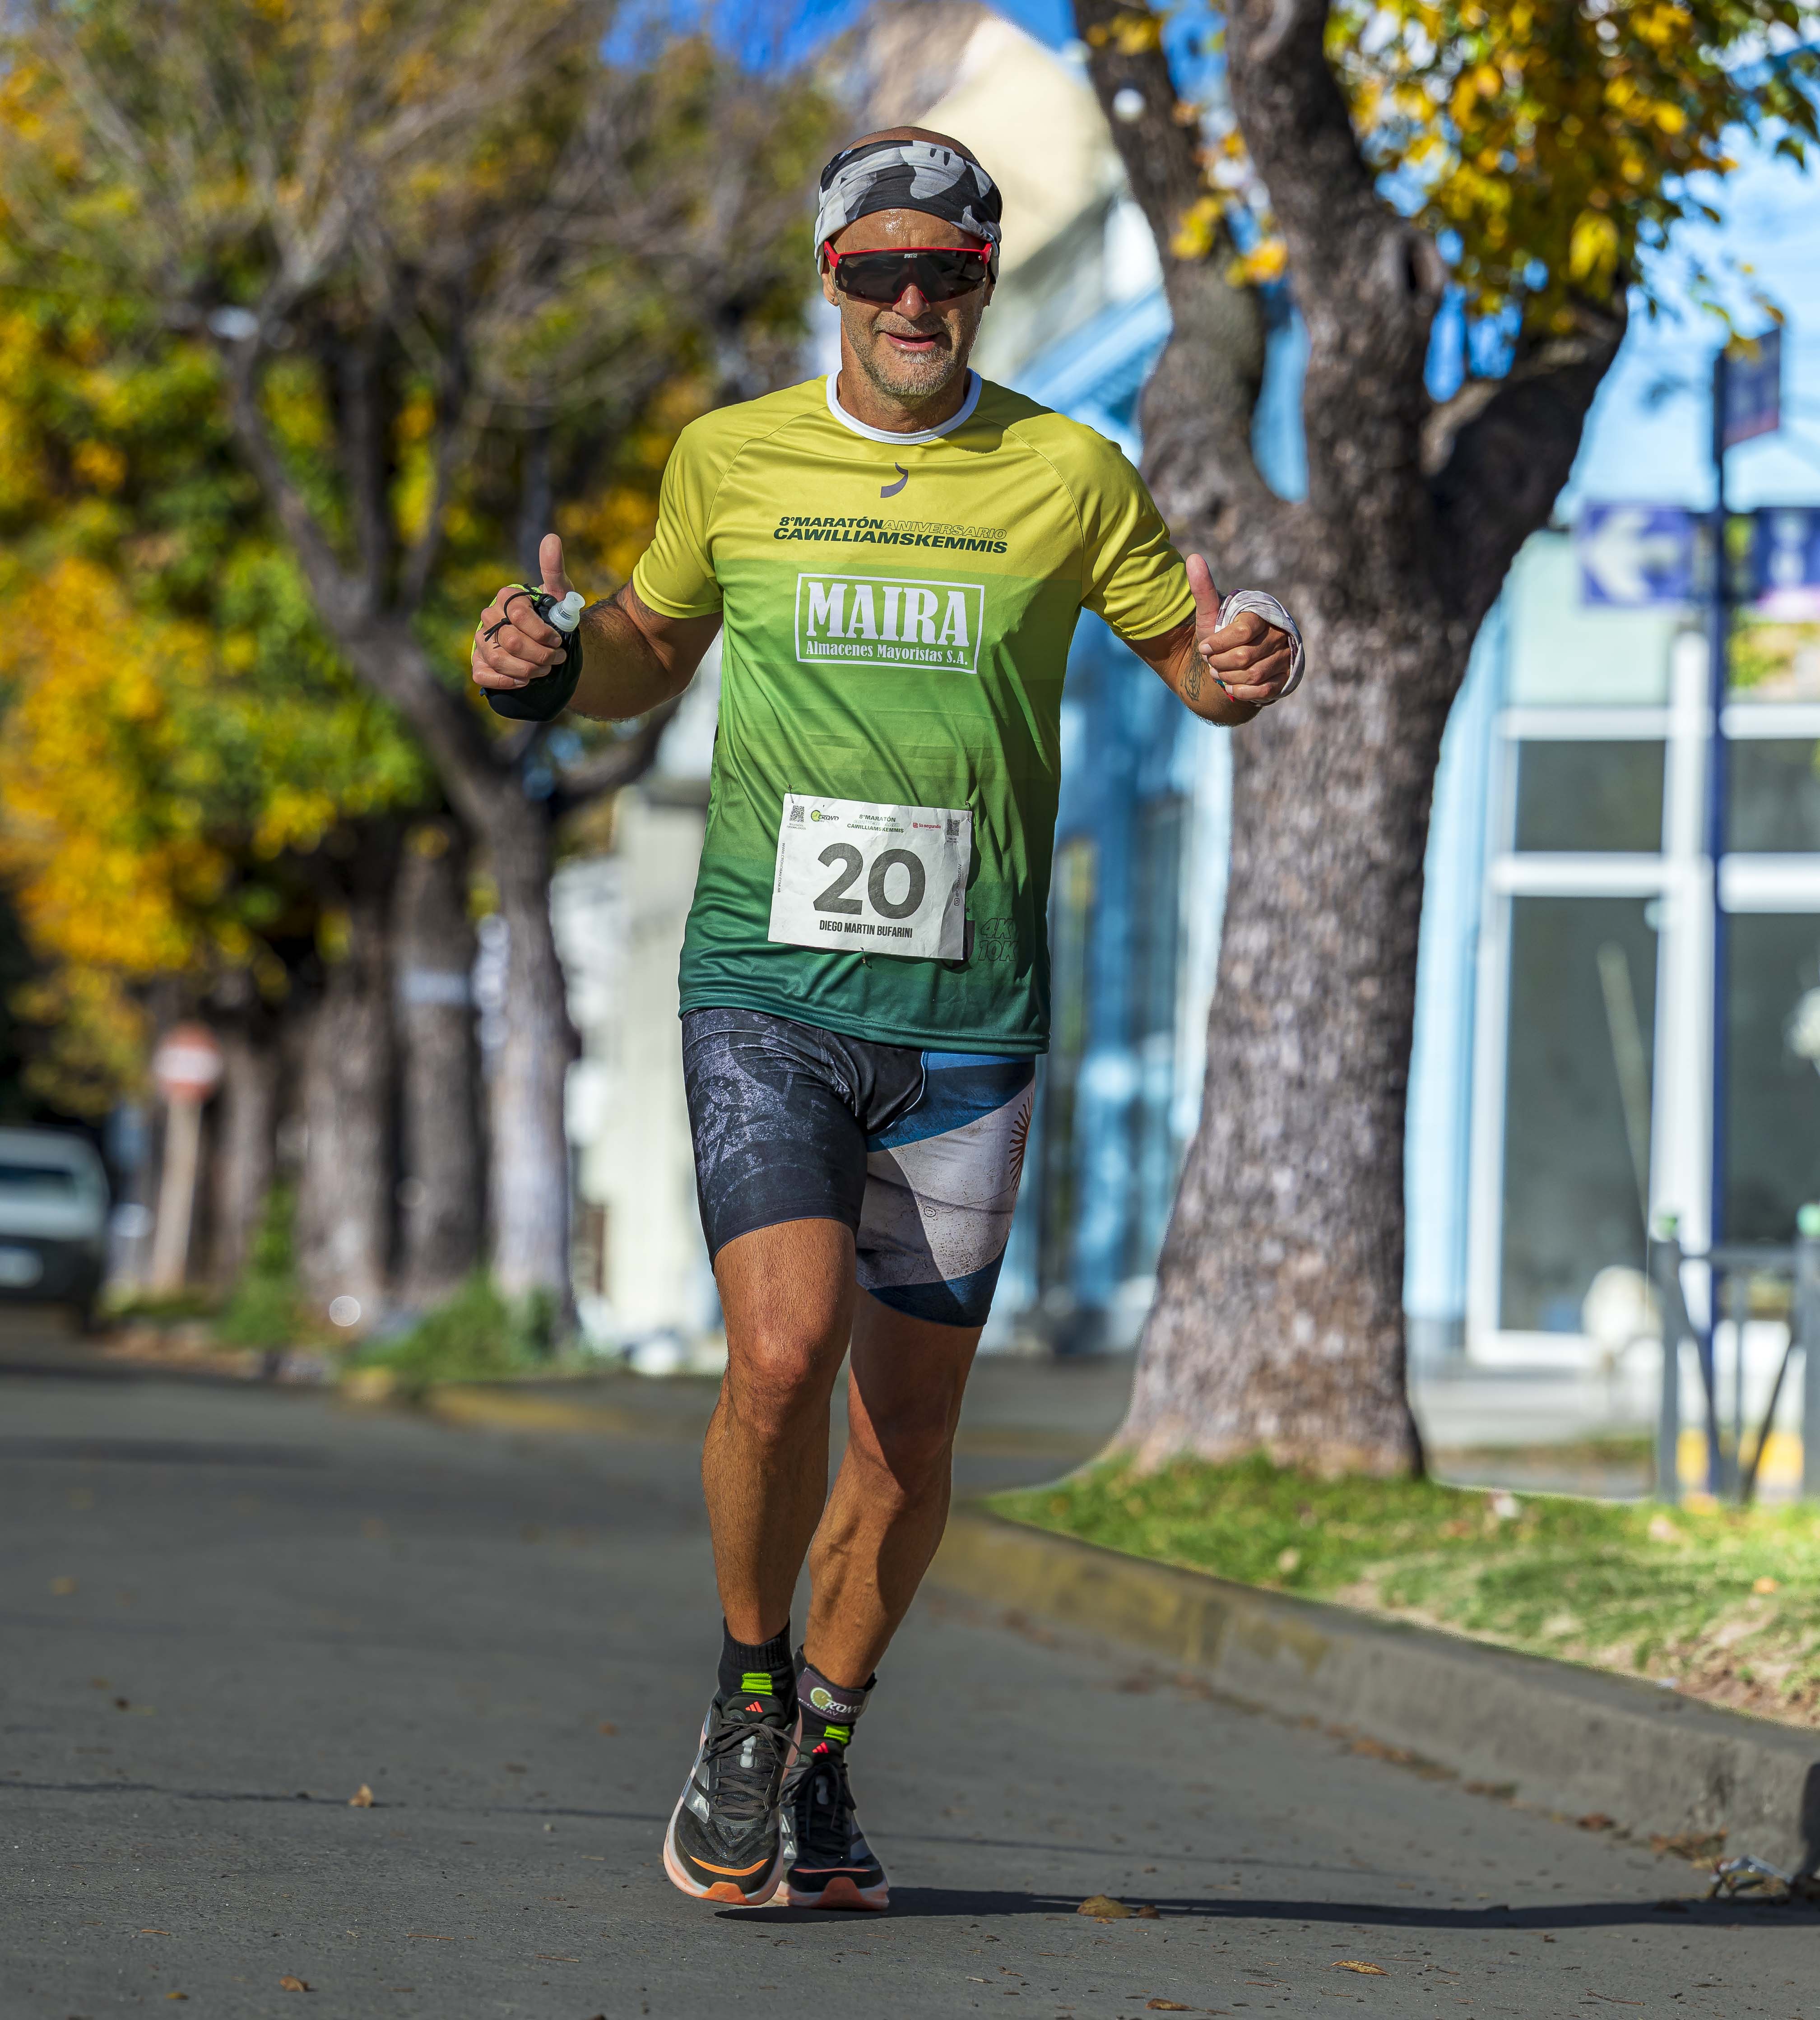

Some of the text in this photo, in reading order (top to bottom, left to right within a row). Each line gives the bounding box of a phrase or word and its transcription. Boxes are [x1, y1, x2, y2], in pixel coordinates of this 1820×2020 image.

[773, 528, 1008, 554] CAWILLIAMSKEMMIS
[806, 582, 969, 647] MAIRA
[806, 641, 968, 666] Almacenes Mayoristas S.A.
[847, 823, 904, 833] CAWILLIAMSKEMMIS
[813, 843, 926, 919] 20
[819, 920, 913, 938] DIEGO MARTIN BUFARINI
[980, 917, 1014, 939] 4K
[978, 940, 1019, 962] 10K
